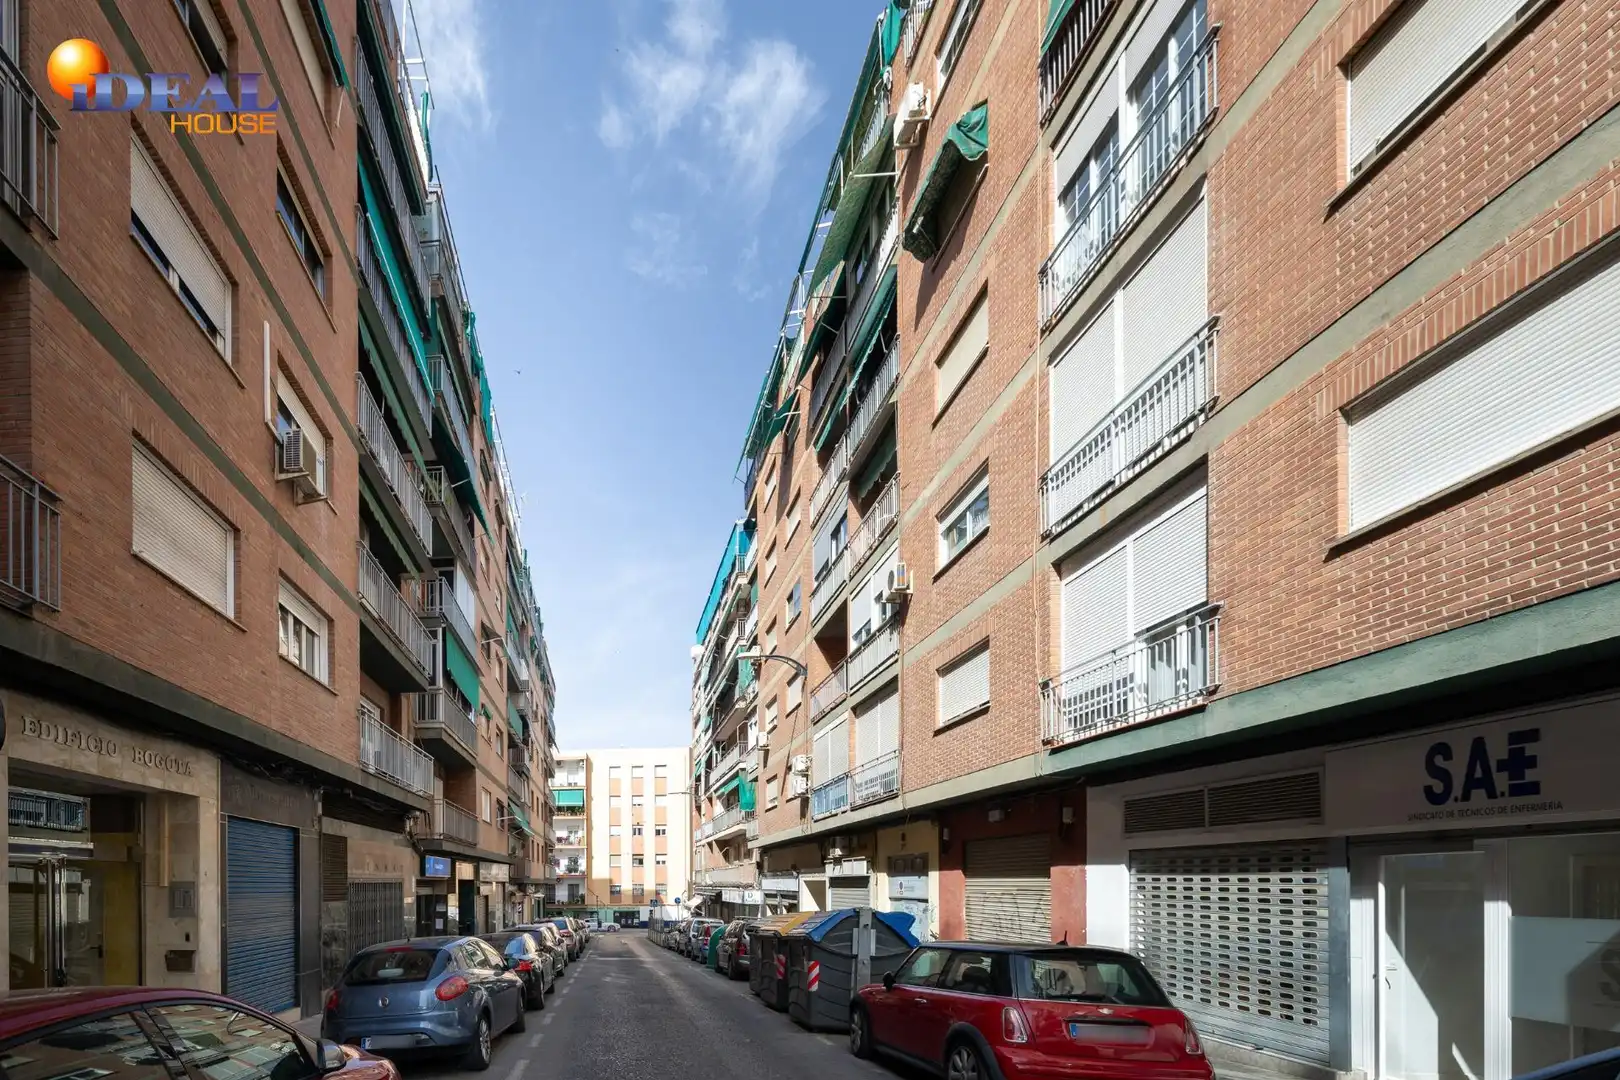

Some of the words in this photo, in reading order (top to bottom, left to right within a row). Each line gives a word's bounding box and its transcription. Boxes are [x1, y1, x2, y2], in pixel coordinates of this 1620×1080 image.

[21, 715, 118, 758] EDIFICIO
[132, 746, 193, 776] BOGOTA
[1407, 808, 1444, 822] SINDICATO
[1446, 808, 1456, 819] DE
[1497, 805, 1508, 815] DE
